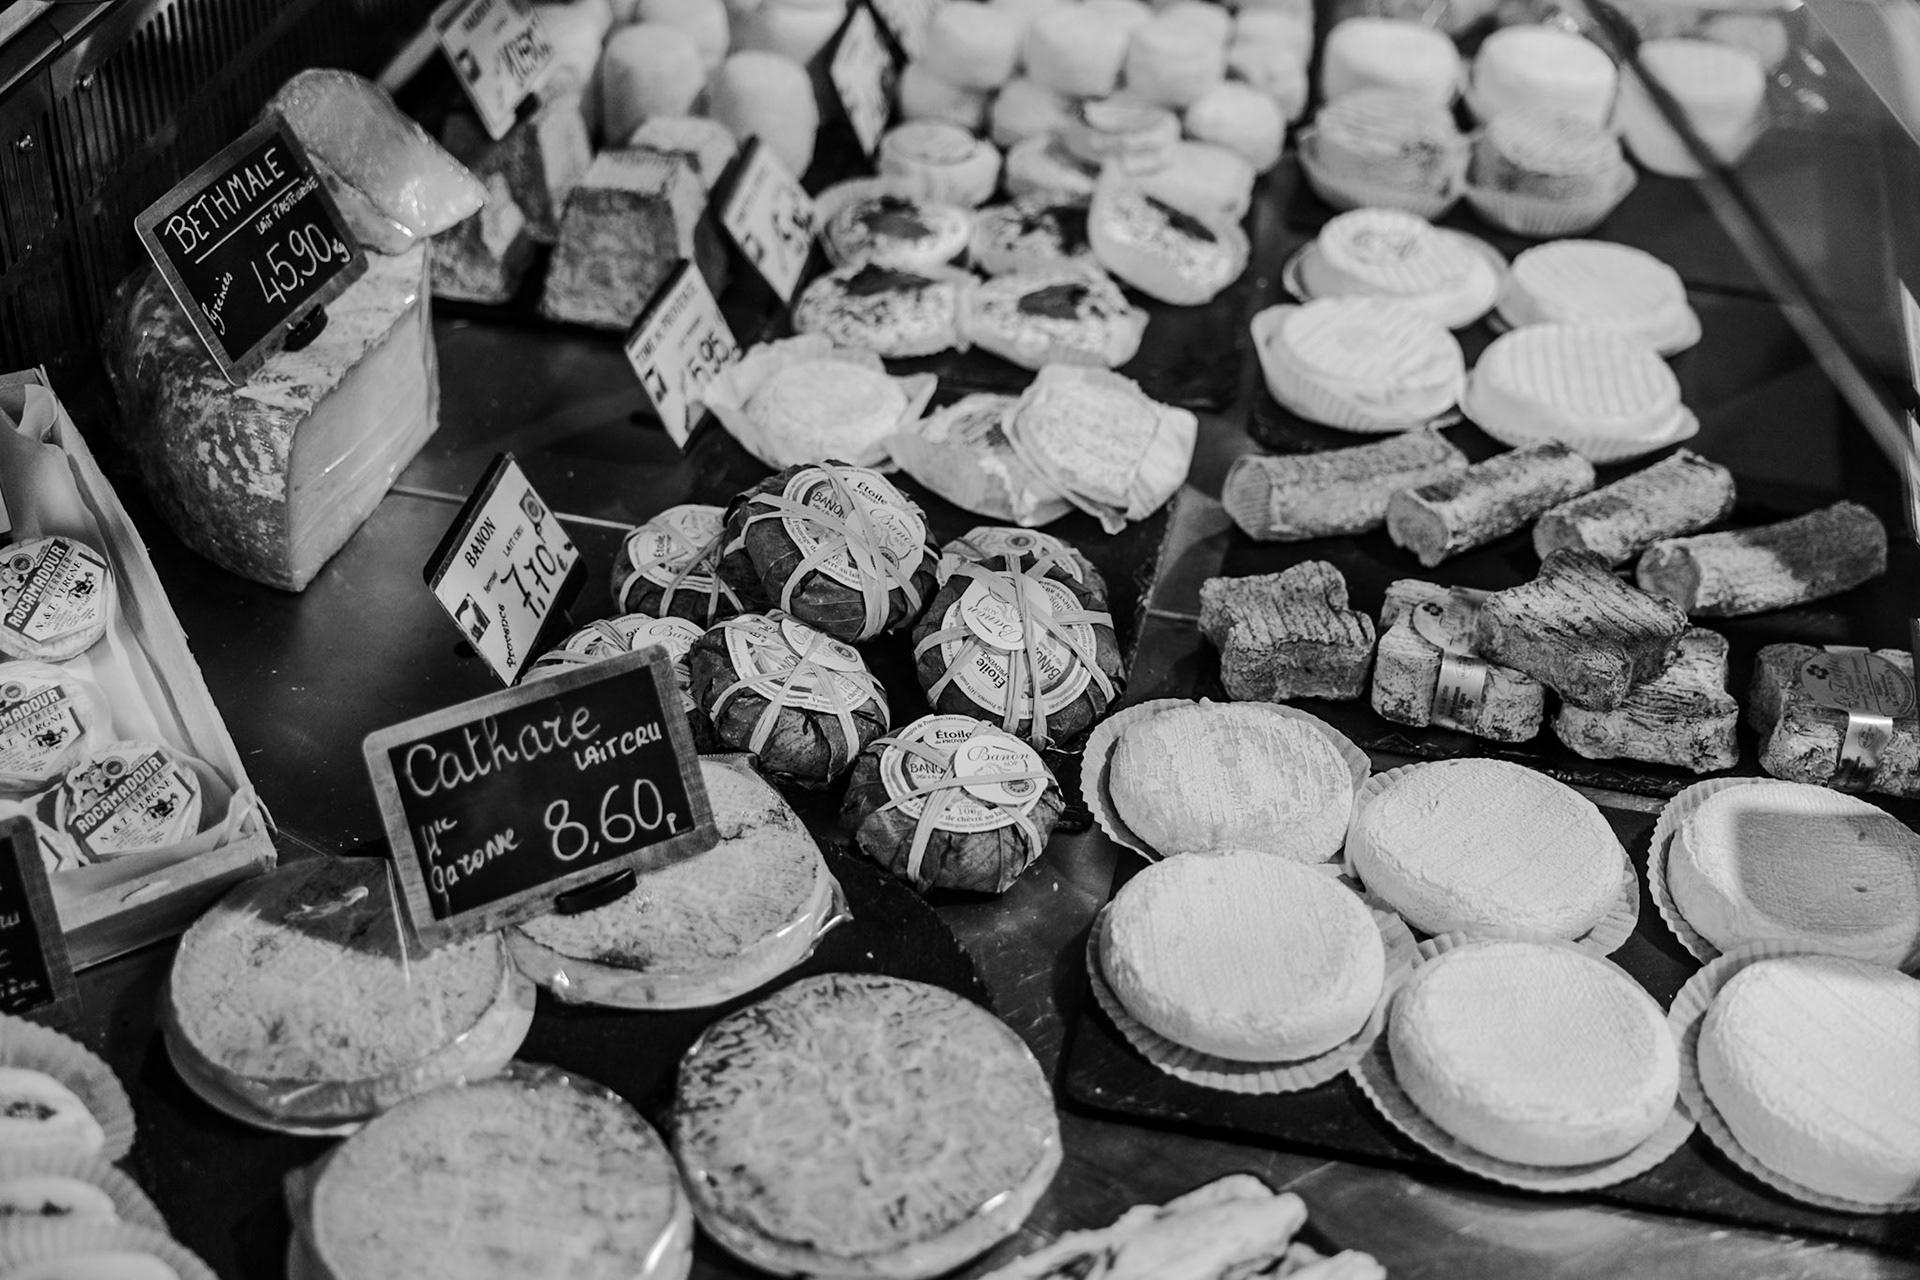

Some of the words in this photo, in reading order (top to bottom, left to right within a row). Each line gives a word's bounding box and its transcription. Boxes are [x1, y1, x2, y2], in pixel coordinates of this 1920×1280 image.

[164, 147, 285, 254] BETHMALE
[251, 223, 331, 303] 45,90
[857, 482, 888, 505] Étoile
[464, 516, 497, 568] BANON
[870, 508, 919, 552] Banon
[8, 545, 66, 628] ROCAMADOUR
[45, 557, 73, 596] FERMIER
[54, 560, 83, 599] VERGNE
[967, 606, 1025, 643] Banon
[976, 656, 1006, 689] Étoile
[15, 703, 60, 732] FERMIER
[20, 712, 67, 739] VERGNE
[405, 706, 601, 797] Cathare
[909, 762, 947, 775] BANO
[967, 745, 1031, 763] Banon
[76, 756, 163, 834] ROCAMADOUR
[124, 771, 165, 808] FERMIER
[132, 779, 174, 814] VERGNE
[544, 778, 664, 862] 8,60
